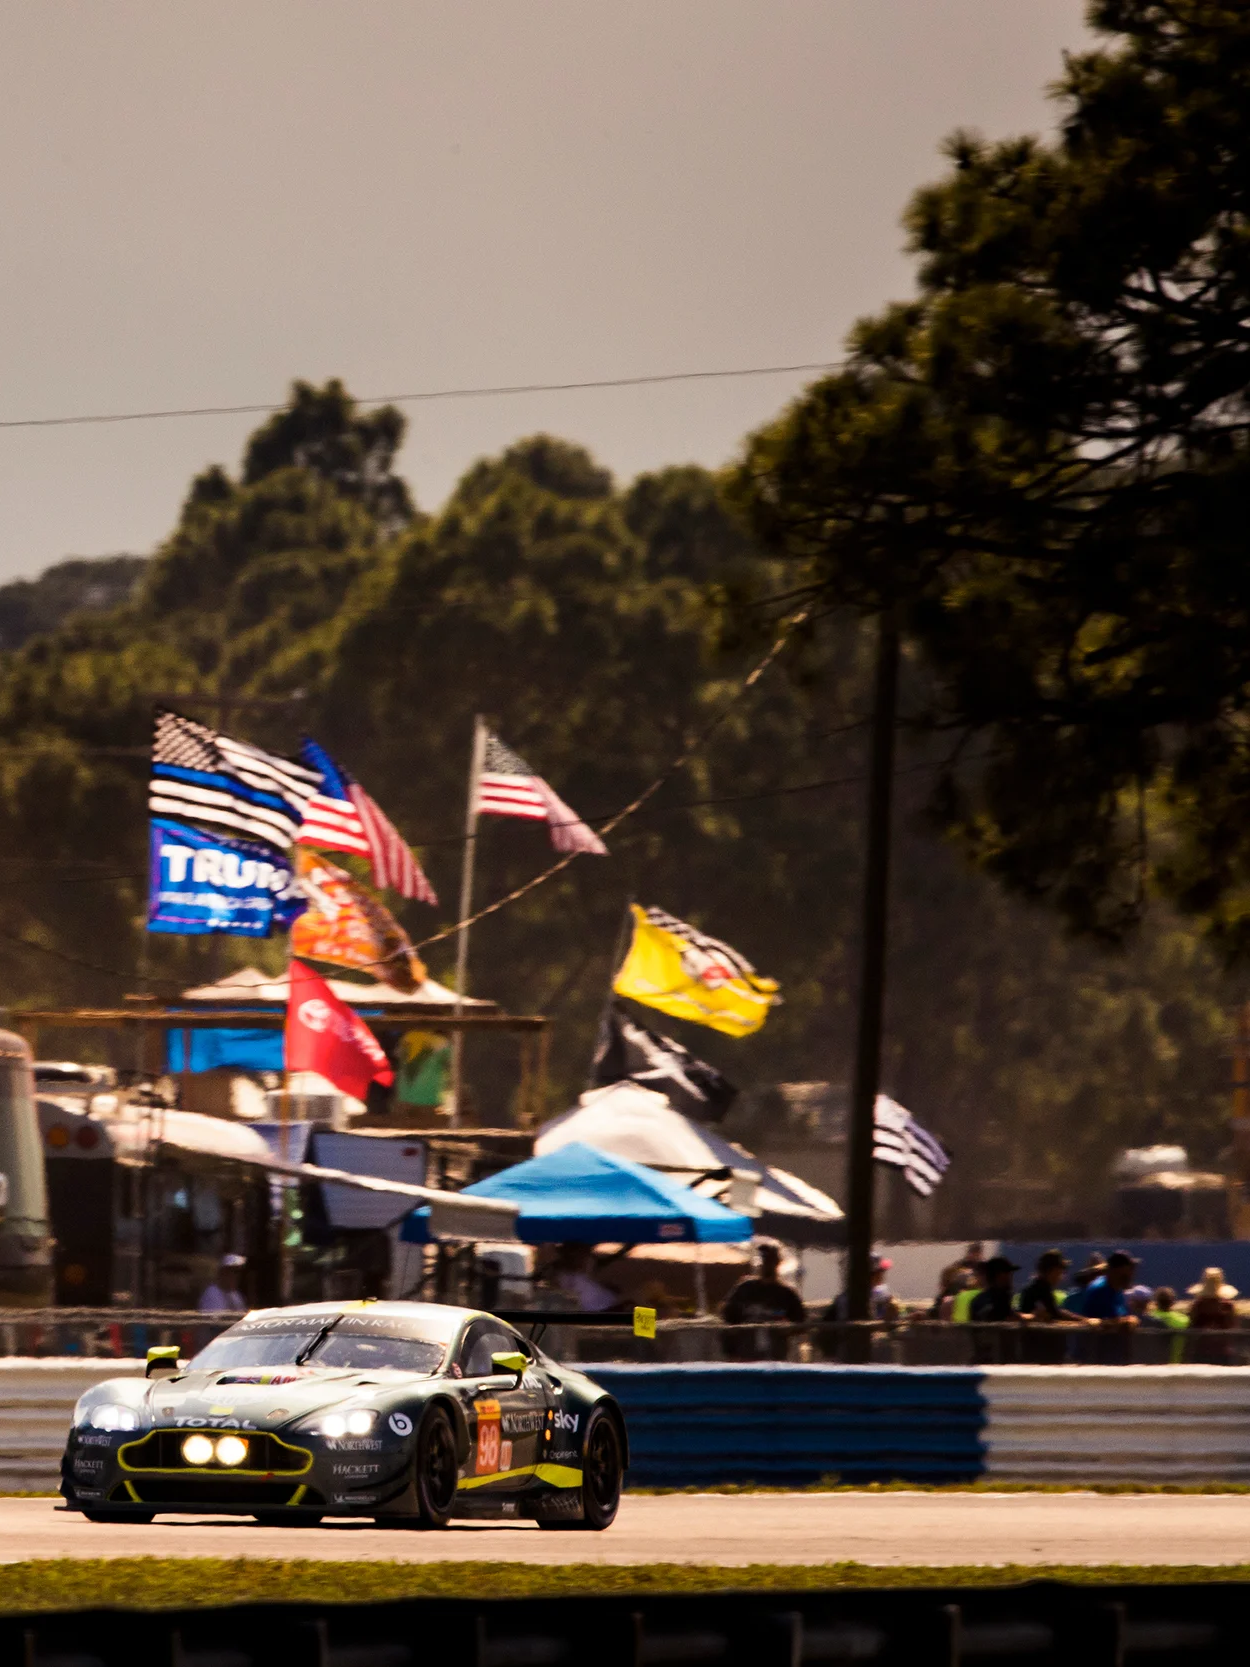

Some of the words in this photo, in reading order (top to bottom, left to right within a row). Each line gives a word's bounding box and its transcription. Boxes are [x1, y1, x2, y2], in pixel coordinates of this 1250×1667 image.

[234, 1318, 296, 1332] ASTON
[174, 1416, 257, 1430] TOTAL
[554, 1409, 580, 1433] sky
[479, 1424, 499, 1466] 98
[75, 1459, 104, 1470] HACKETT
[333, 1464, 380, 1475] HACKETT
